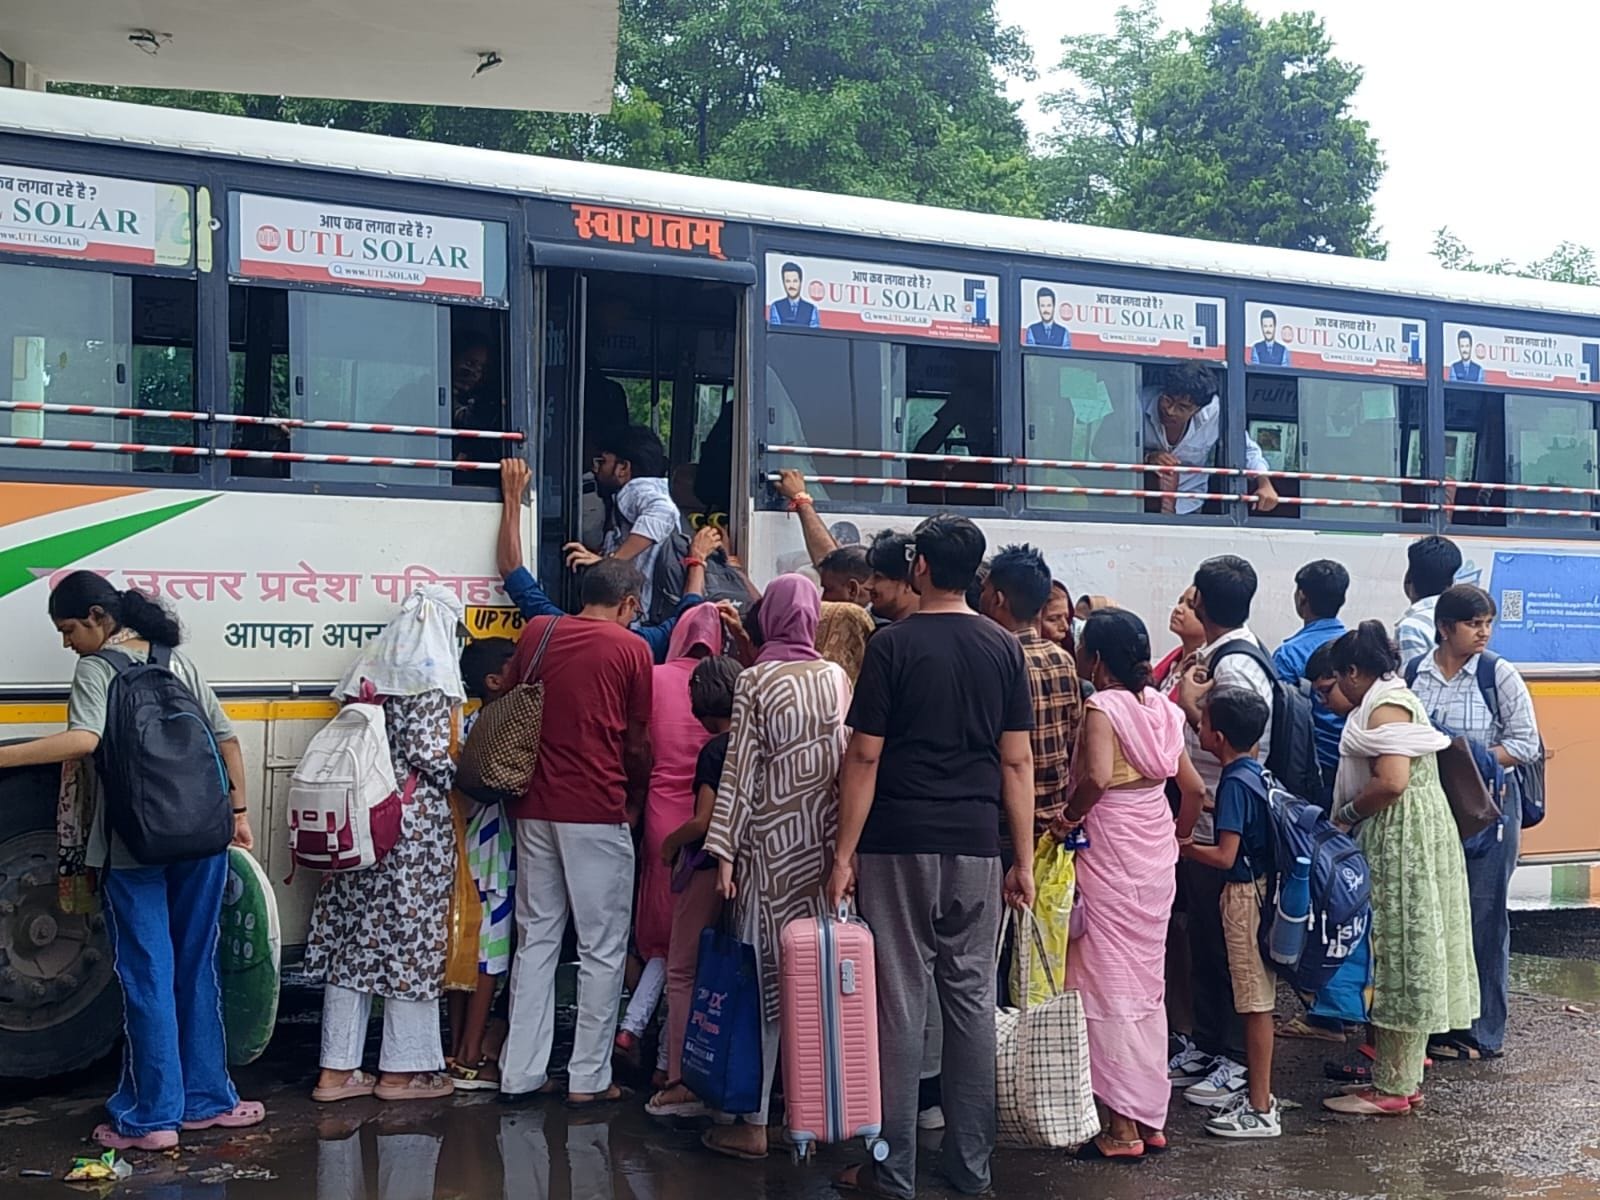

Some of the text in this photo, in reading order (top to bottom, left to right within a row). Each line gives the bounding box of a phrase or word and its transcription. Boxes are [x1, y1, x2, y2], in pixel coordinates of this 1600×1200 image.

[17, 178, 54, 196] लगवा
[56, 180, 74, 198] रहे
[14, 198, 140, 235] SOLAR
[320, 214, 342, 230] आप
[343, 217, 363, 231] कब
[365, 219, 396, 235] लगवा
[398, 220, 413, 237] रहे
[571, 204, 728, 260] स्वागतम्
[286, 228, 354, 258] UTL
[363, 237, 470, 270] SOLAR
[344, 268, 420, 281] www.UTL.SOLAR
[852, 271, 867, 283] आप
[884, 274, 906, 287] लगवा
[829, 281, 957, 313] UTL SOLAR
[1076, 304, 1185, 331] UTL SOLAR
[1297, 326, 1397, 353] UTL SOLAR
[1488, 344, 1574, 368] UTL SOLAR
[122, 570, 247, 601] उत्तर
[256, 560, 363, 603] प्रदेश
[224, 623, 314, 649] आपका
